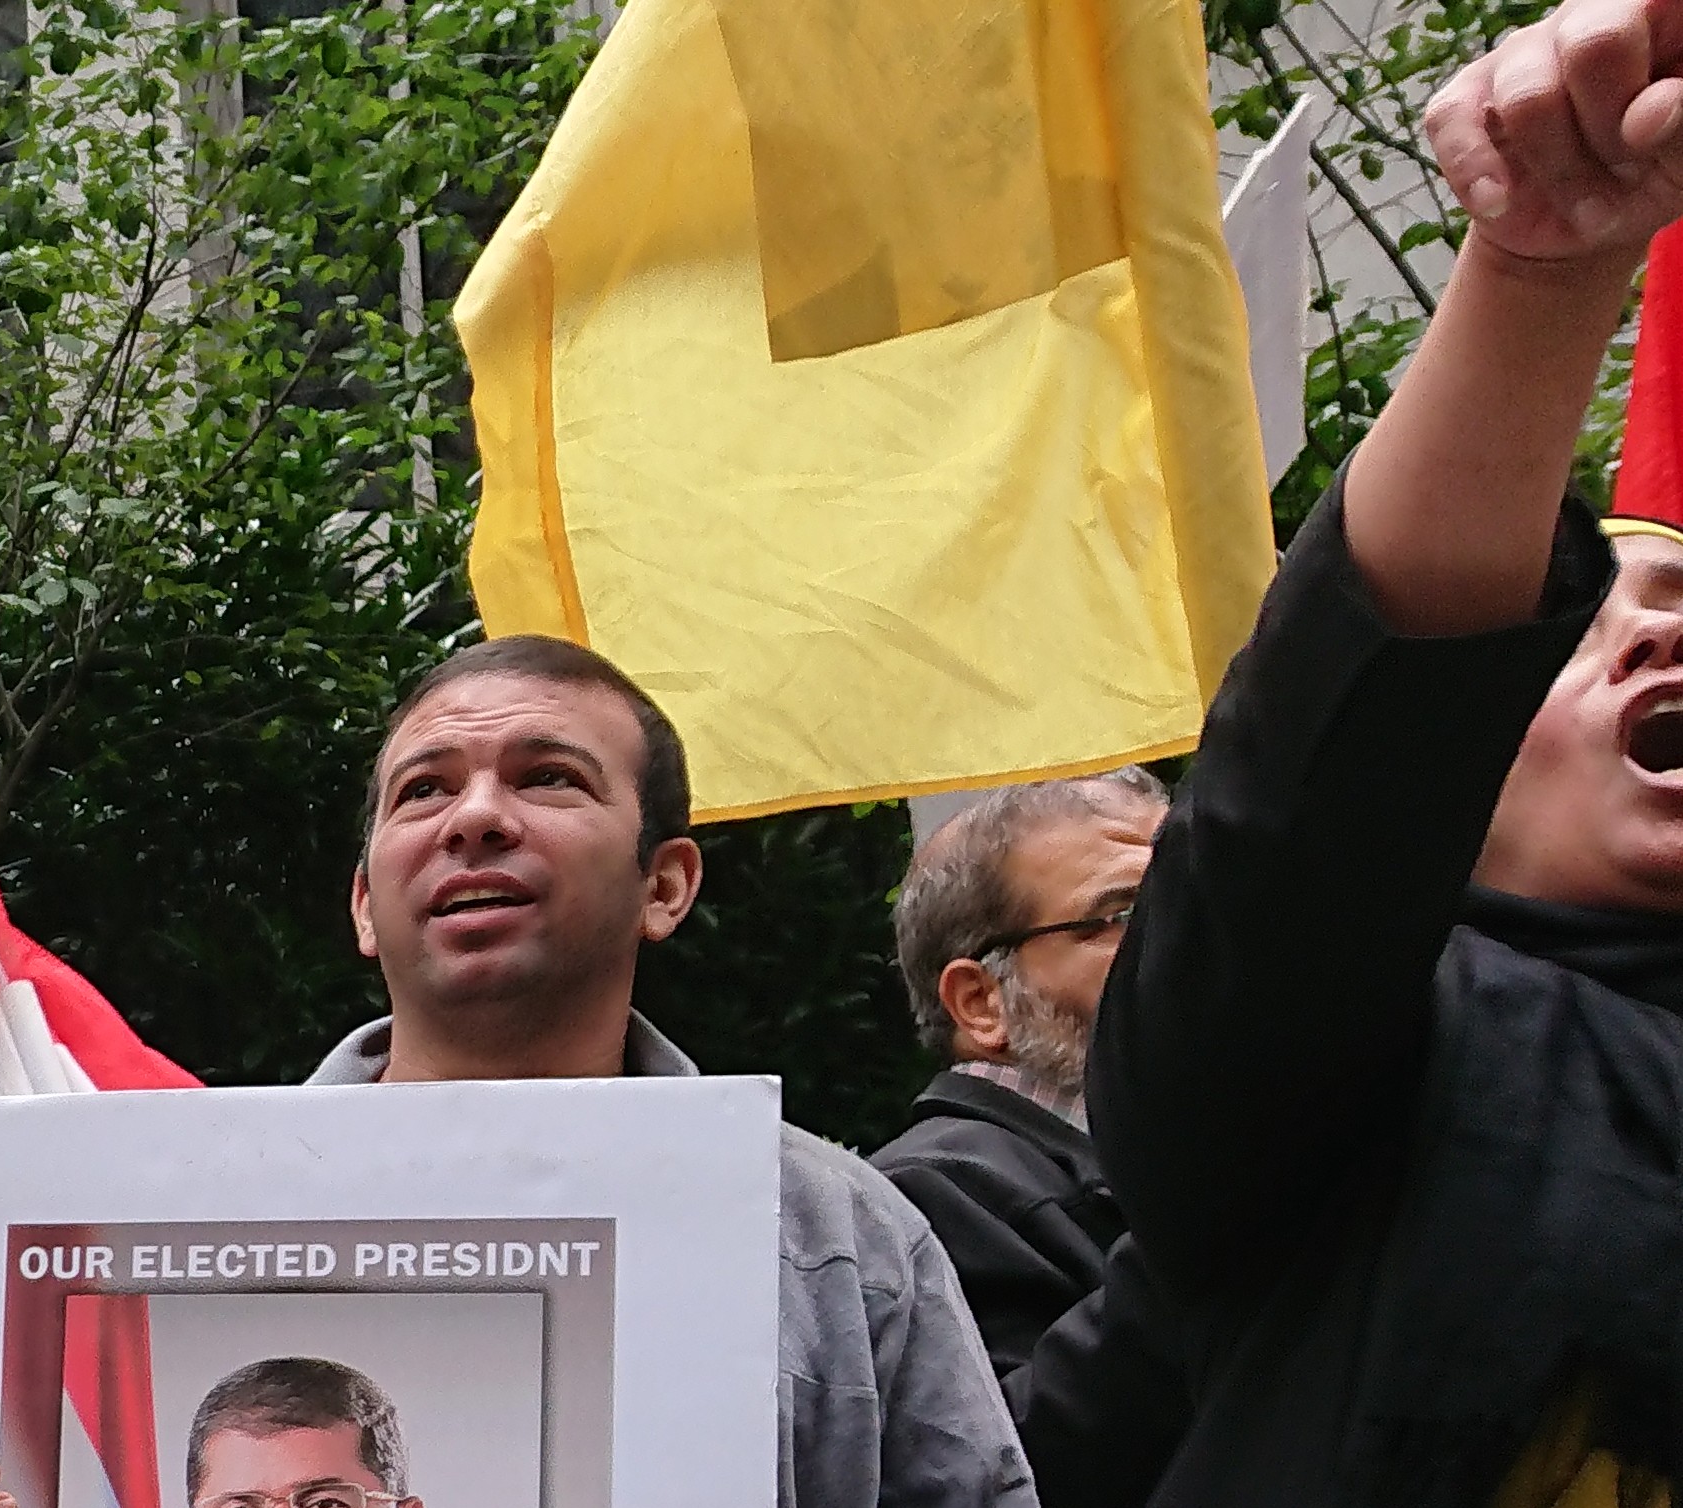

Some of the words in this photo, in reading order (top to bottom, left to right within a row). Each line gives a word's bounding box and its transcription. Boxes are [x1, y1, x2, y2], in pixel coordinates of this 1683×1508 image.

[18, 1246, 114, 1280] OUR
[131, 1243, 337, 1280] ELECTED
[353, 1241, 601, 1278] PRESIDNT
